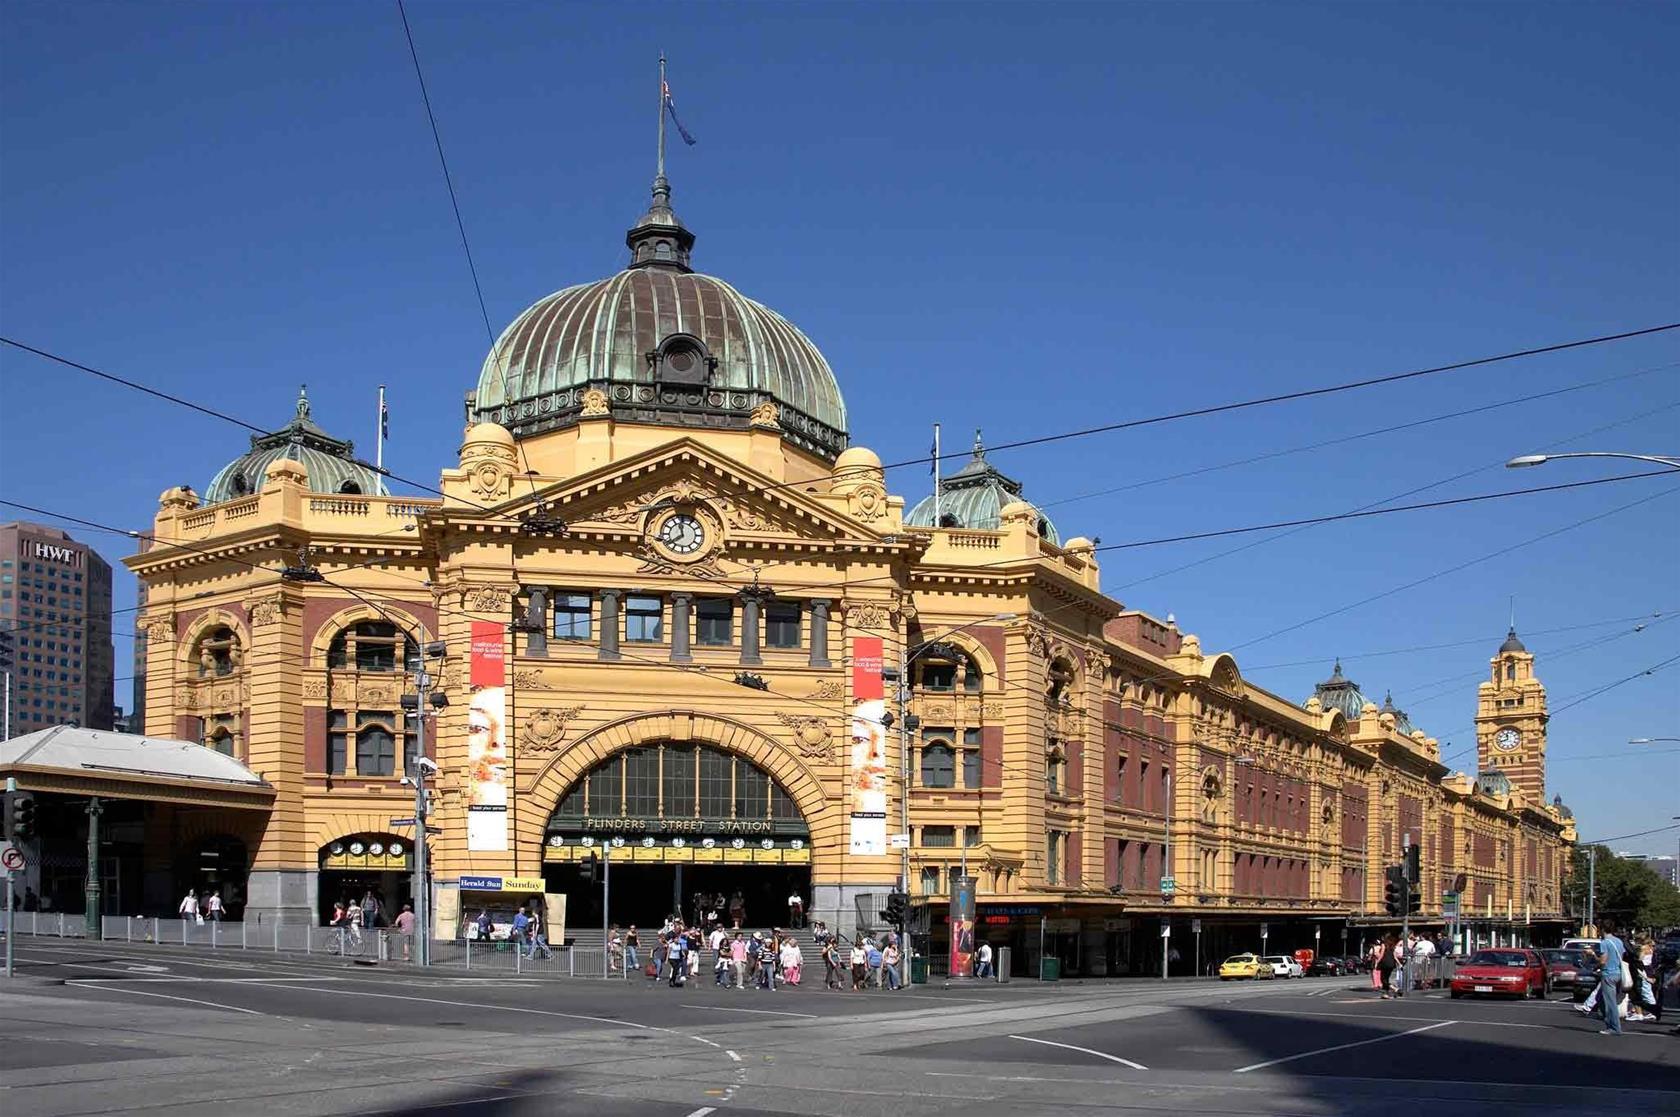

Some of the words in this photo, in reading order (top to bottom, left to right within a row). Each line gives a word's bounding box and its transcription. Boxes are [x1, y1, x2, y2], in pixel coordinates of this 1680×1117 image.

[36, 543, 74, 562] HWT
[587, 818, 646, 829] FLINDERS
[660, 820, 705, 830] STREET
[719, 821, 771, 831] STATION
[505, 880, 541, 890] Sunday
